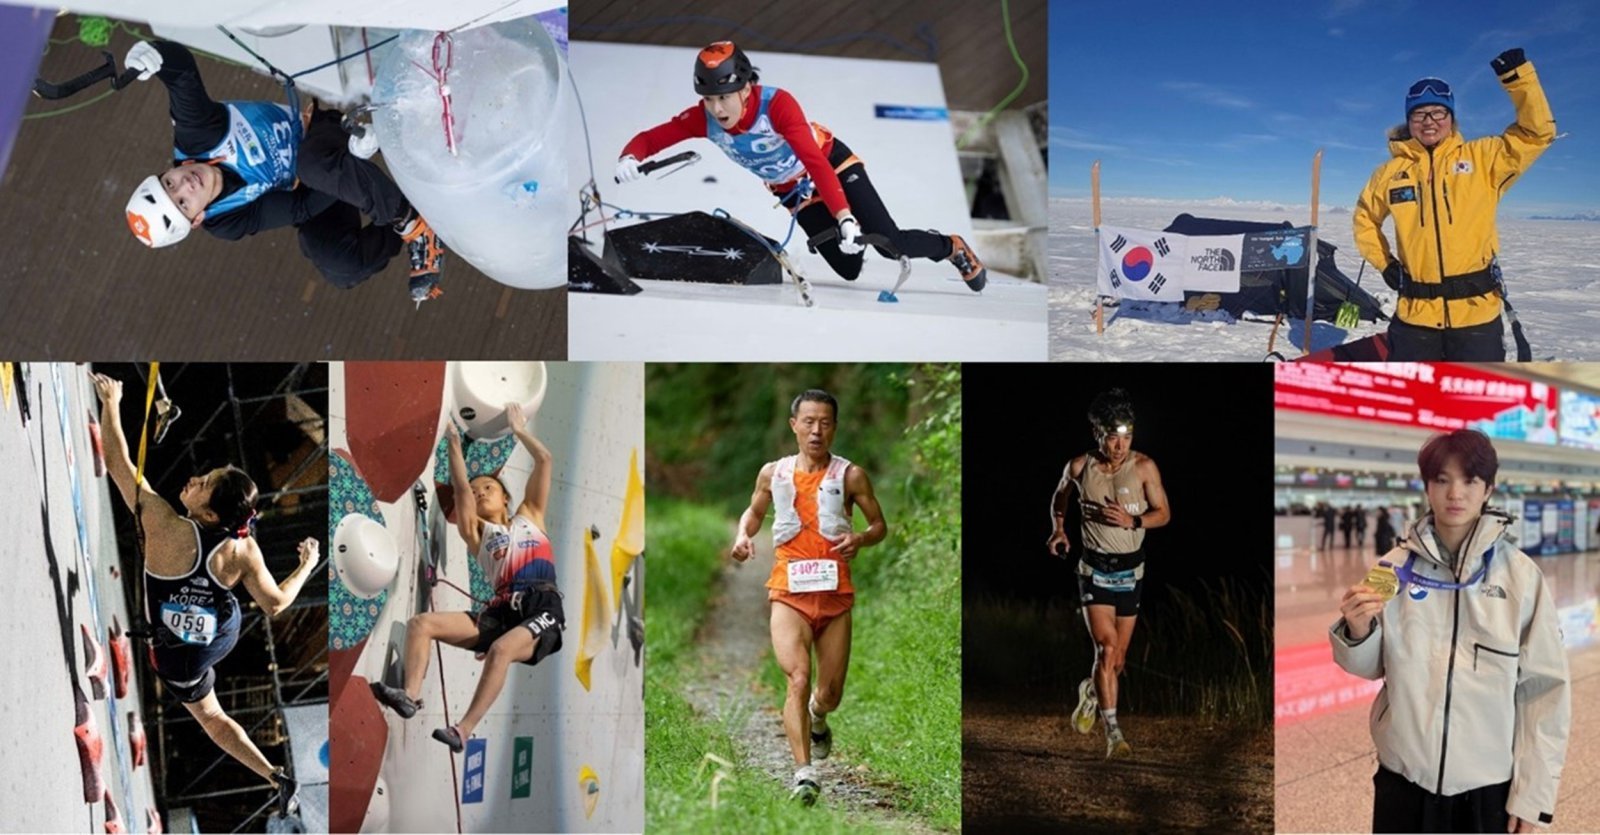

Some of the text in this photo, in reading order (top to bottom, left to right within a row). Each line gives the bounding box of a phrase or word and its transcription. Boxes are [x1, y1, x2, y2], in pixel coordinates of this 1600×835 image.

[1205, 248, 1221, 256] THE
[1191, 256, 1221, 264] NORTH
[1198, 263, 1219, 272] FACE
[168, 593, 214, 606] KOREA
[171, 613, 205, 633] 059
